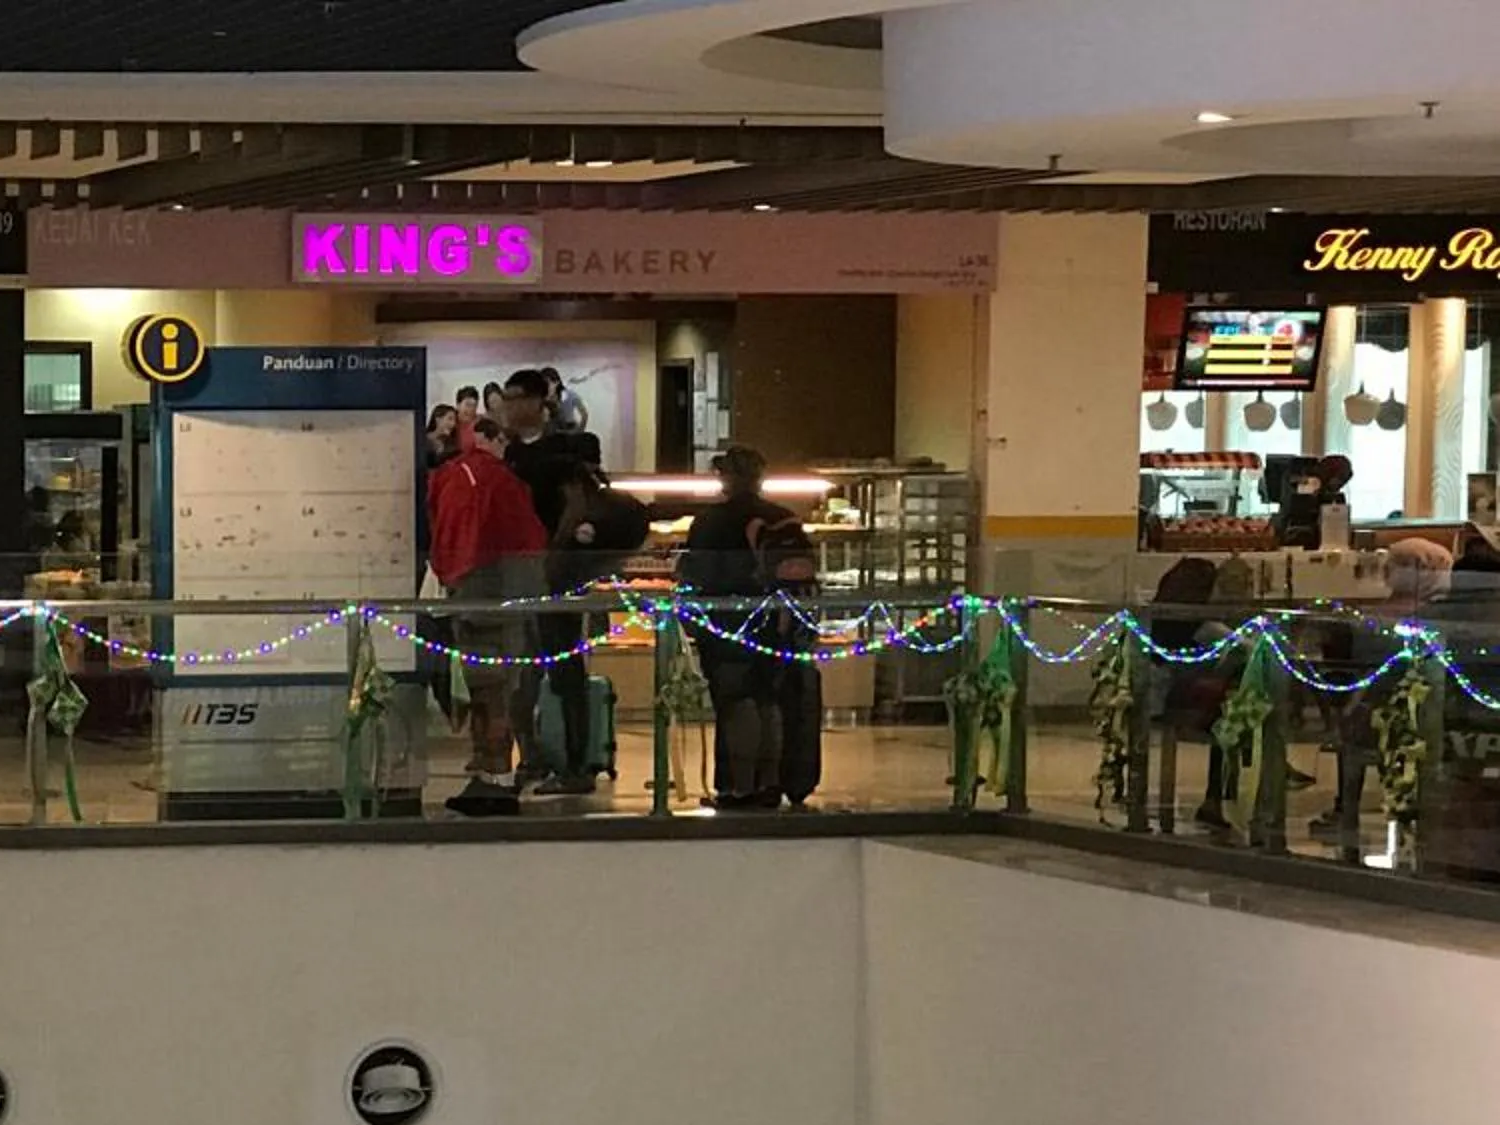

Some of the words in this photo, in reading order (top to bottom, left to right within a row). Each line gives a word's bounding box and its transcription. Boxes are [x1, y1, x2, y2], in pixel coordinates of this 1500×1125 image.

[302, 222, 532, 276] KING'S
[555, 249, 718, 275] BAKERY
[1303, 227, 1437, 282] Kenny
[1439, 226, 1500, 279] Ro
[262, 355, 334, 371] Panduan
[346, 355, 416, 374] Directory
